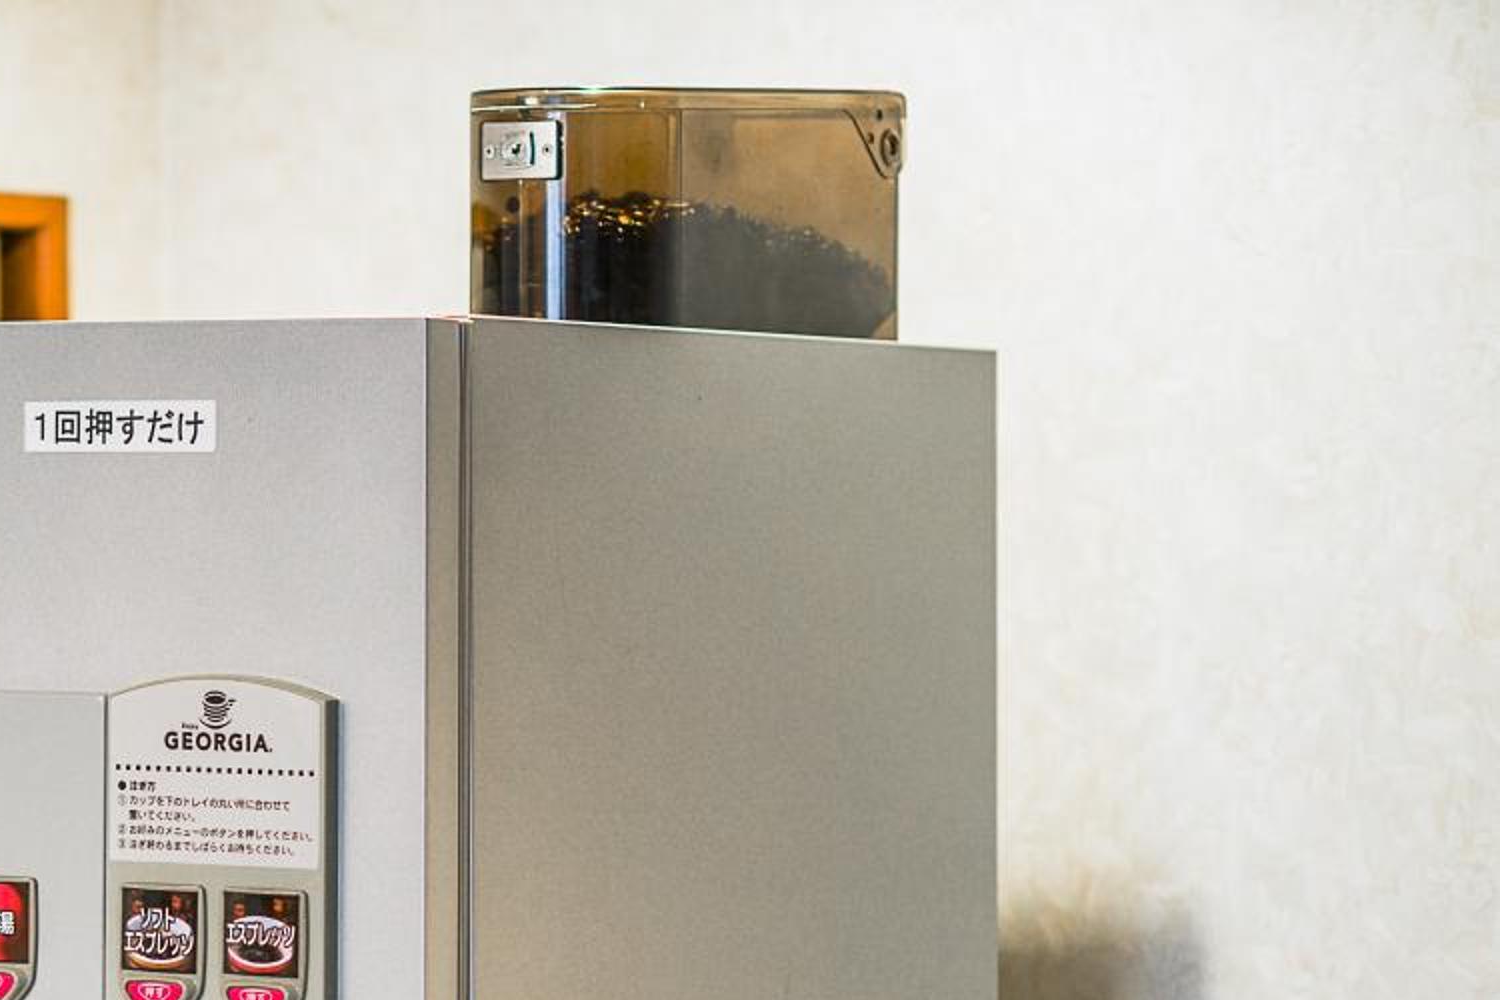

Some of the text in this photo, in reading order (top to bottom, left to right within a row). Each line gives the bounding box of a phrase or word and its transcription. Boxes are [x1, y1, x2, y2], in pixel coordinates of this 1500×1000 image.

[35, 408, 205, 445] 1回押すだけ
[164, 731, 268, 752] GEORGIA
[140, 907, 176, 931] ソフト
[124, 931, 194, 956] エスプレッソ
[226, 922, 296, 948] エスプレッソ
